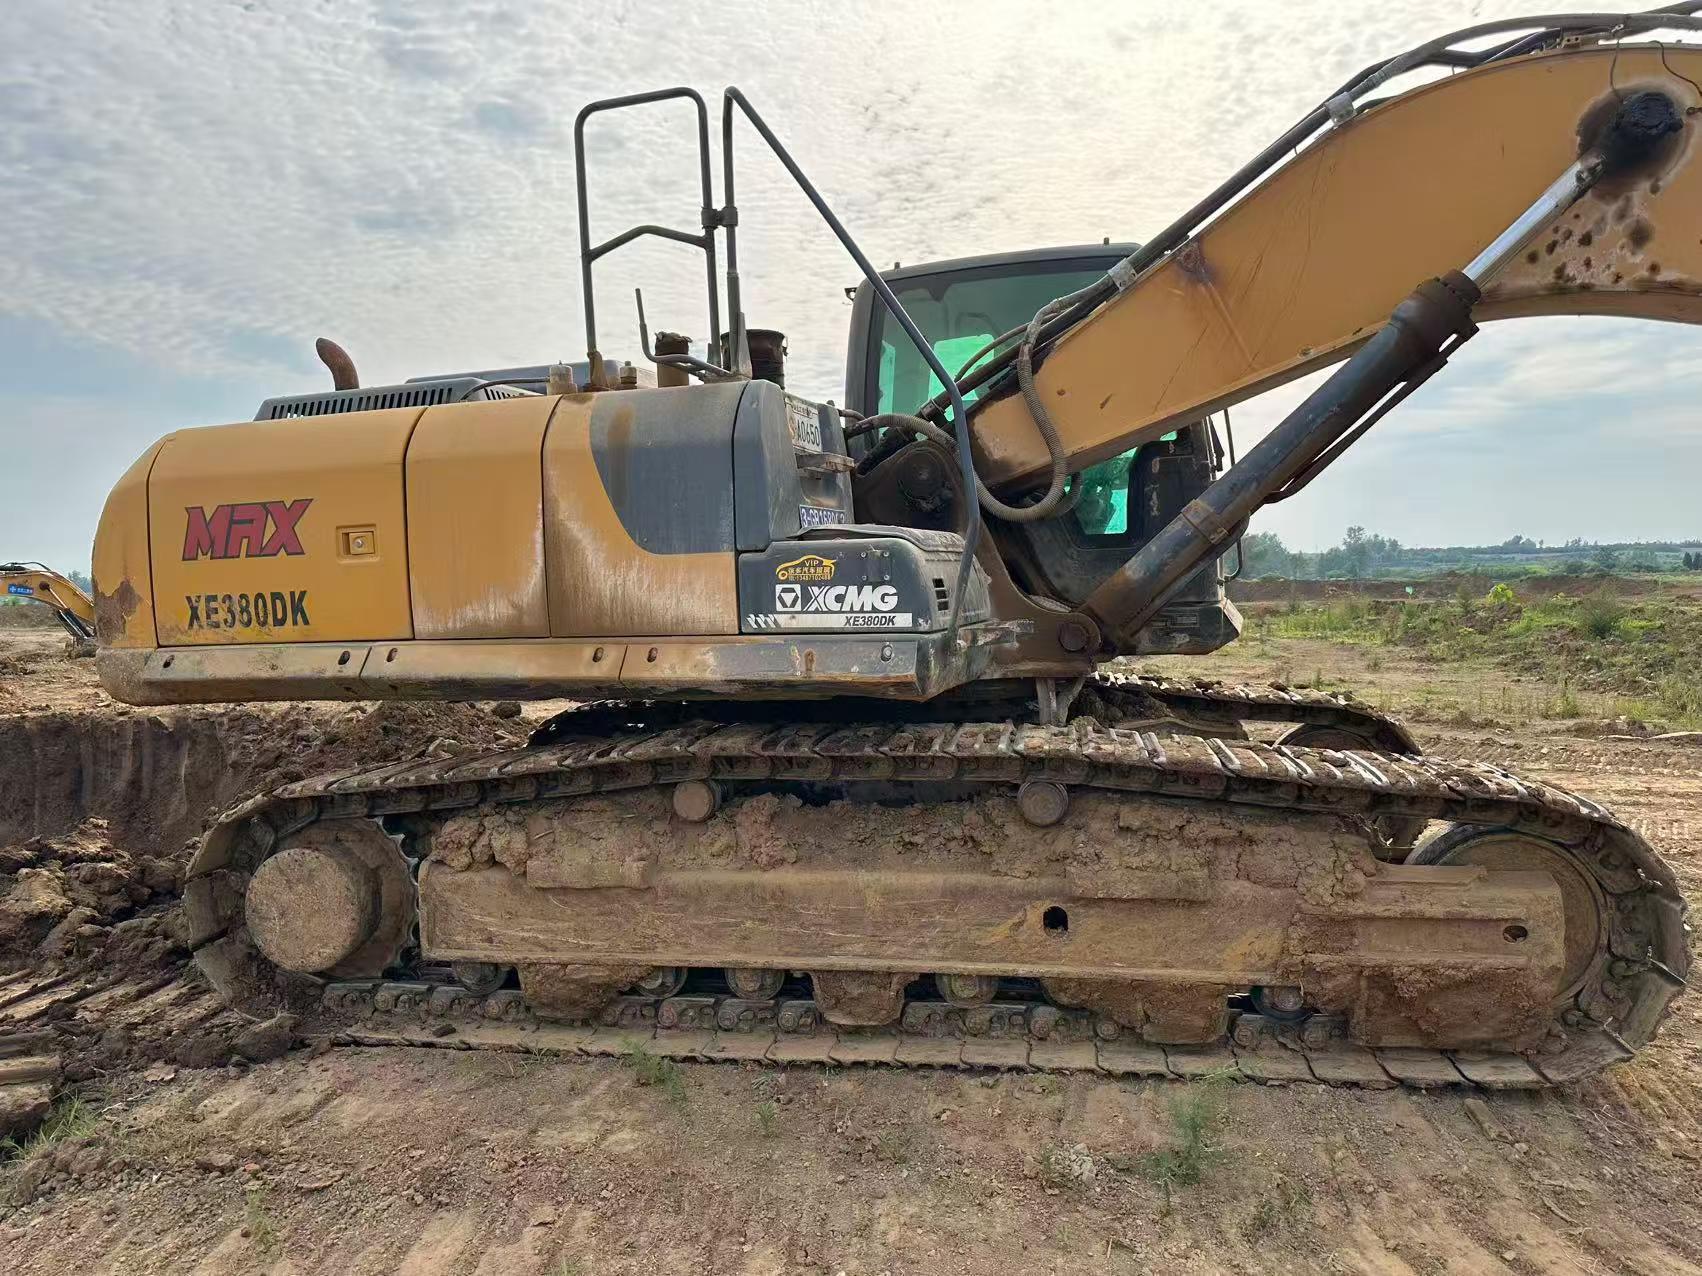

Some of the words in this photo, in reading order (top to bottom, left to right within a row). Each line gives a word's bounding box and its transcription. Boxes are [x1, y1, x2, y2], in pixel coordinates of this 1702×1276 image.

[181, 498, 314, 561] MAX
[804, 559, 819, 567] VIP
[185, 590, 310, 631] XE380DK
[803, 585, 899, 612] XCMG
[844, 615, 897, 627] XE380DK
